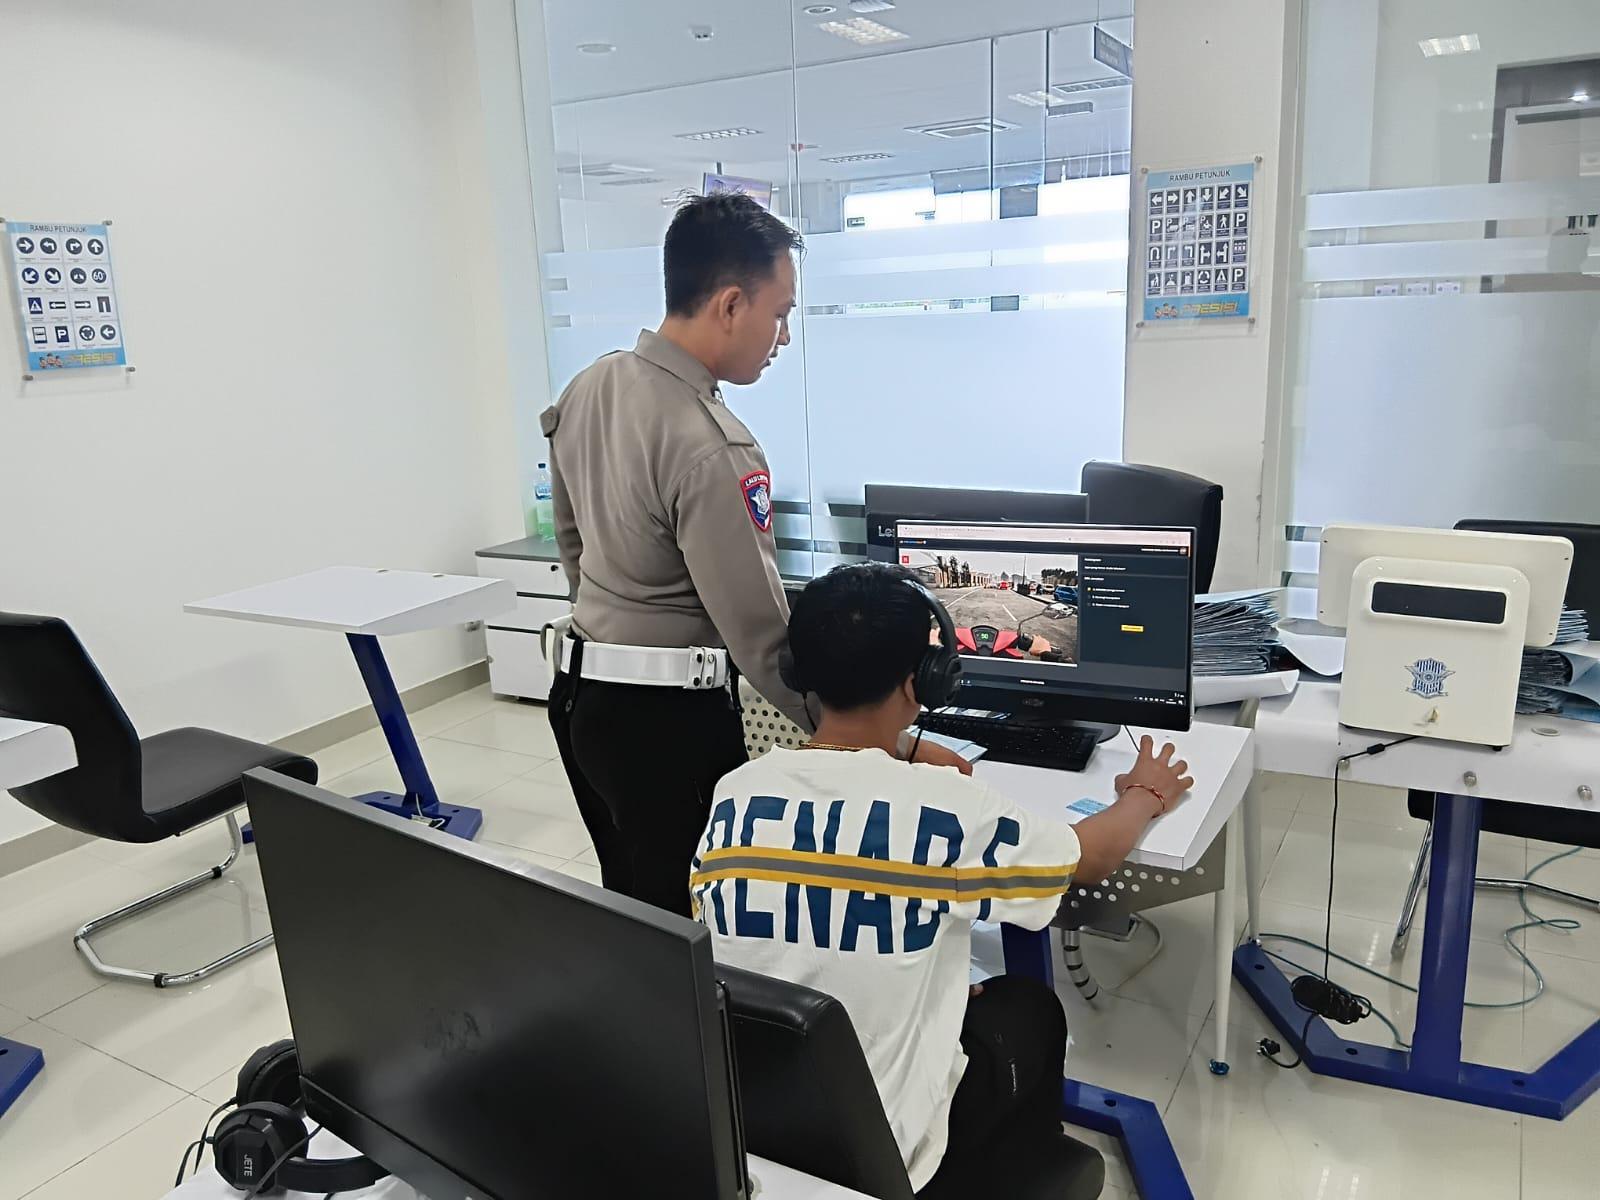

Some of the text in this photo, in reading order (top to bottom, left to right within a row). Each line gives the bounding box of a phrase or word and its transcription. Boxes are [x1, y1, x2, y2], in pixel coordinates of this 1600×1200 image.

[1169, 169, 1231, 182] RAMBU PETUNJUK
[1235, 213, 1246, 227] P
[29, 224, 88, 234] RAMBU PETUNJUK
[1152, 220, 1161, 234] P
[1234, 268, 1244, 282] P
[57, 329, 67, 340] P
[878, 525, 896, 538] Le
[243, 1153, 253, 1177] JETE
